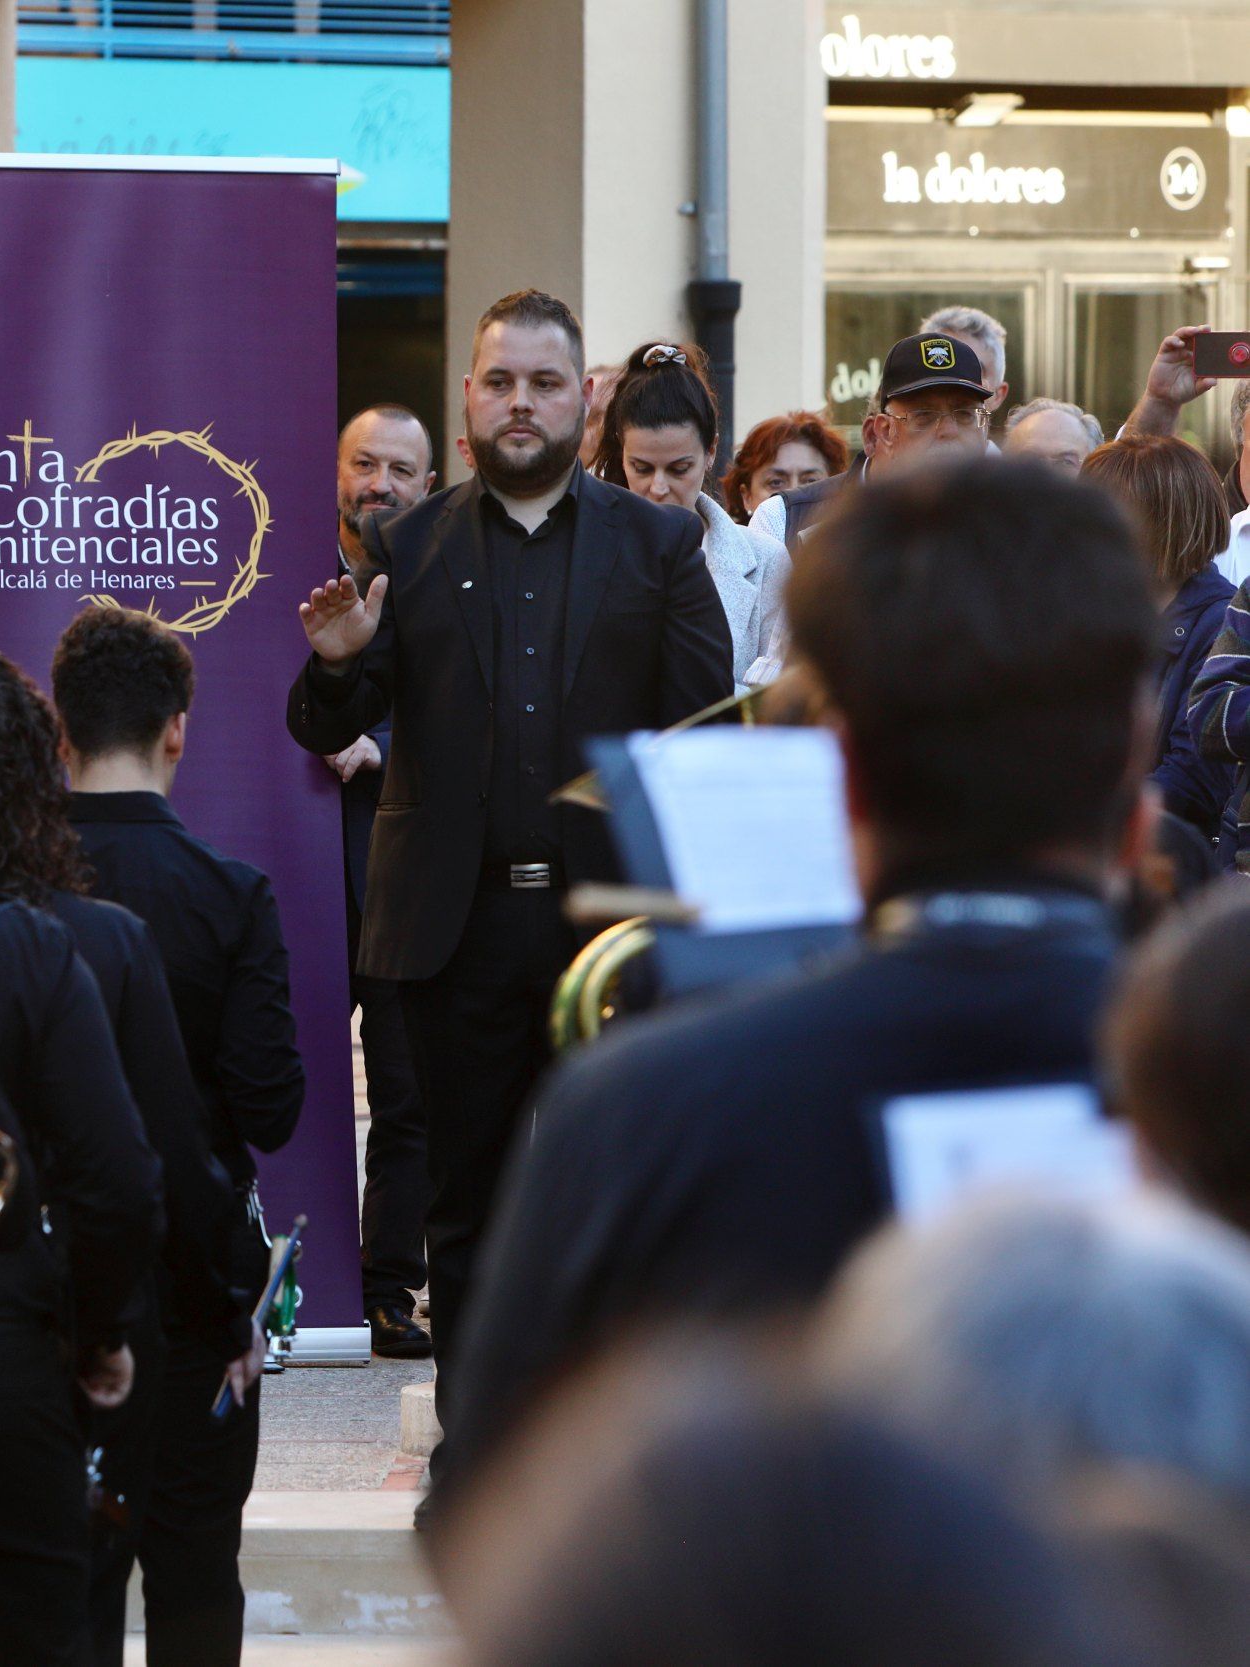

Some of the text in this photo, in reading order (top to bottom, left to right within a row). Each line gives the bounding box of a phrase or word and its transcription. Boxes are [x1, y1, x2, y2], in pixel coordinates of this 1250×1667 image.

[882, 151, 1066, 204] la dolores
[55, 568, 83, 589] de
[90, 569, 176, 590] Henares
